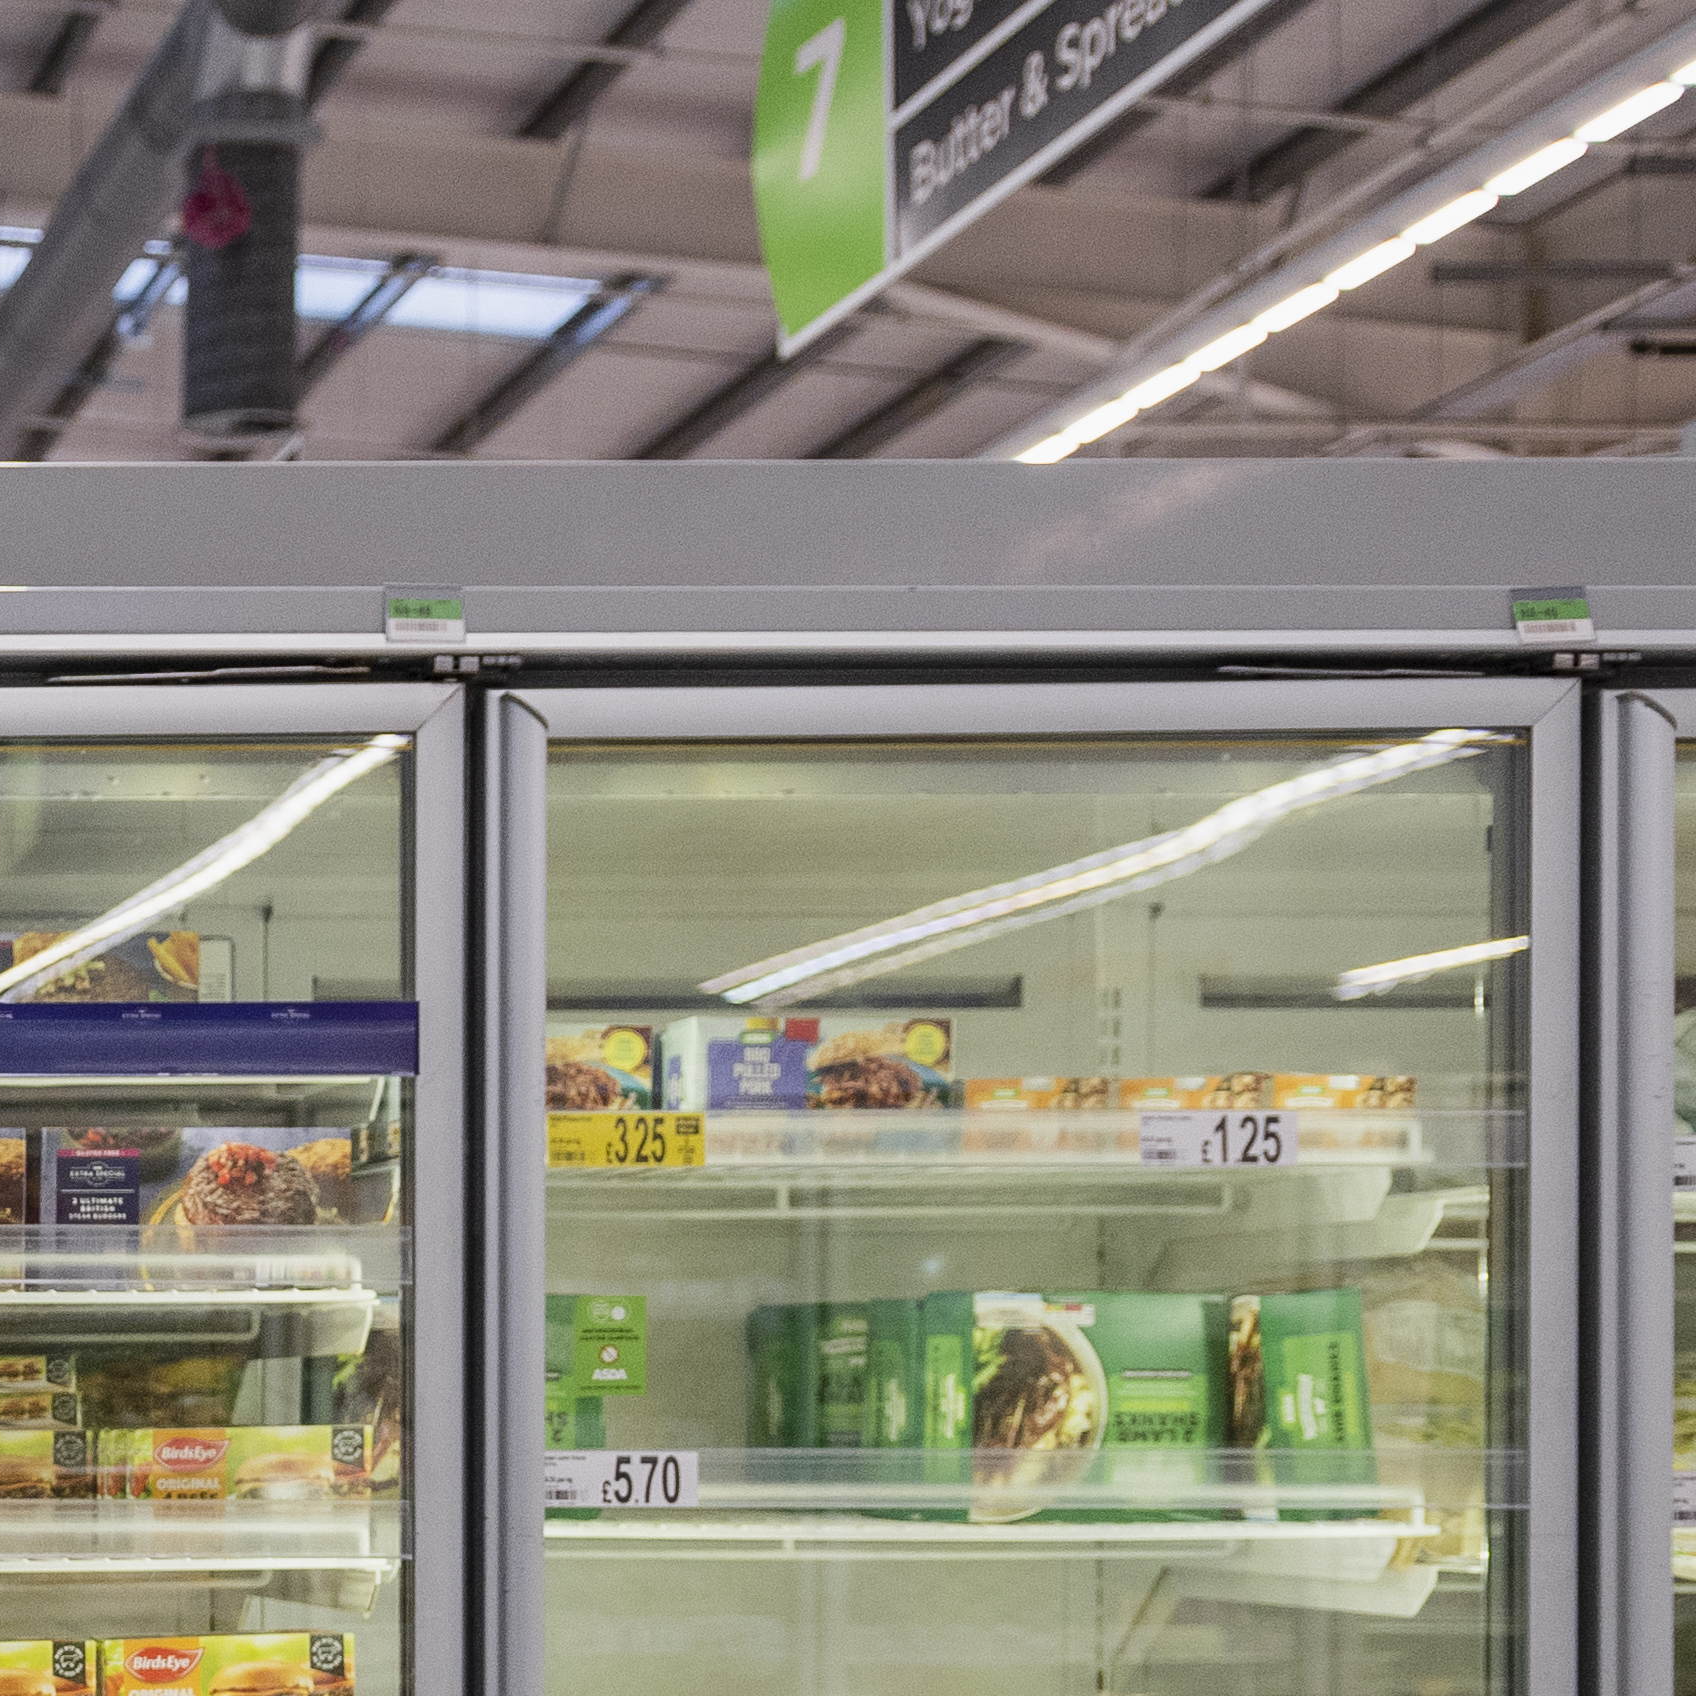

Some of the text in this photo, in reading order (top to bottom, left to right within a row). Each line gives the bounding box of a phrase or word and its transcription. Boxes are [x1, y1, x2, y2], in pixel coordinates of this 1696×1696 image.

[795, 18, 846, 181] 7
[911, 50, 1048, 203] Butter &
[606, 1117, 666, 1163] £3.25
[1202, 1116, 1282, 1163] £1.25
[162, 1445, 216, 1462] BirdsEye
[603, 1455, 681, 1503] £5.70
[133, 1655, 191, 1671] BirdsEye
